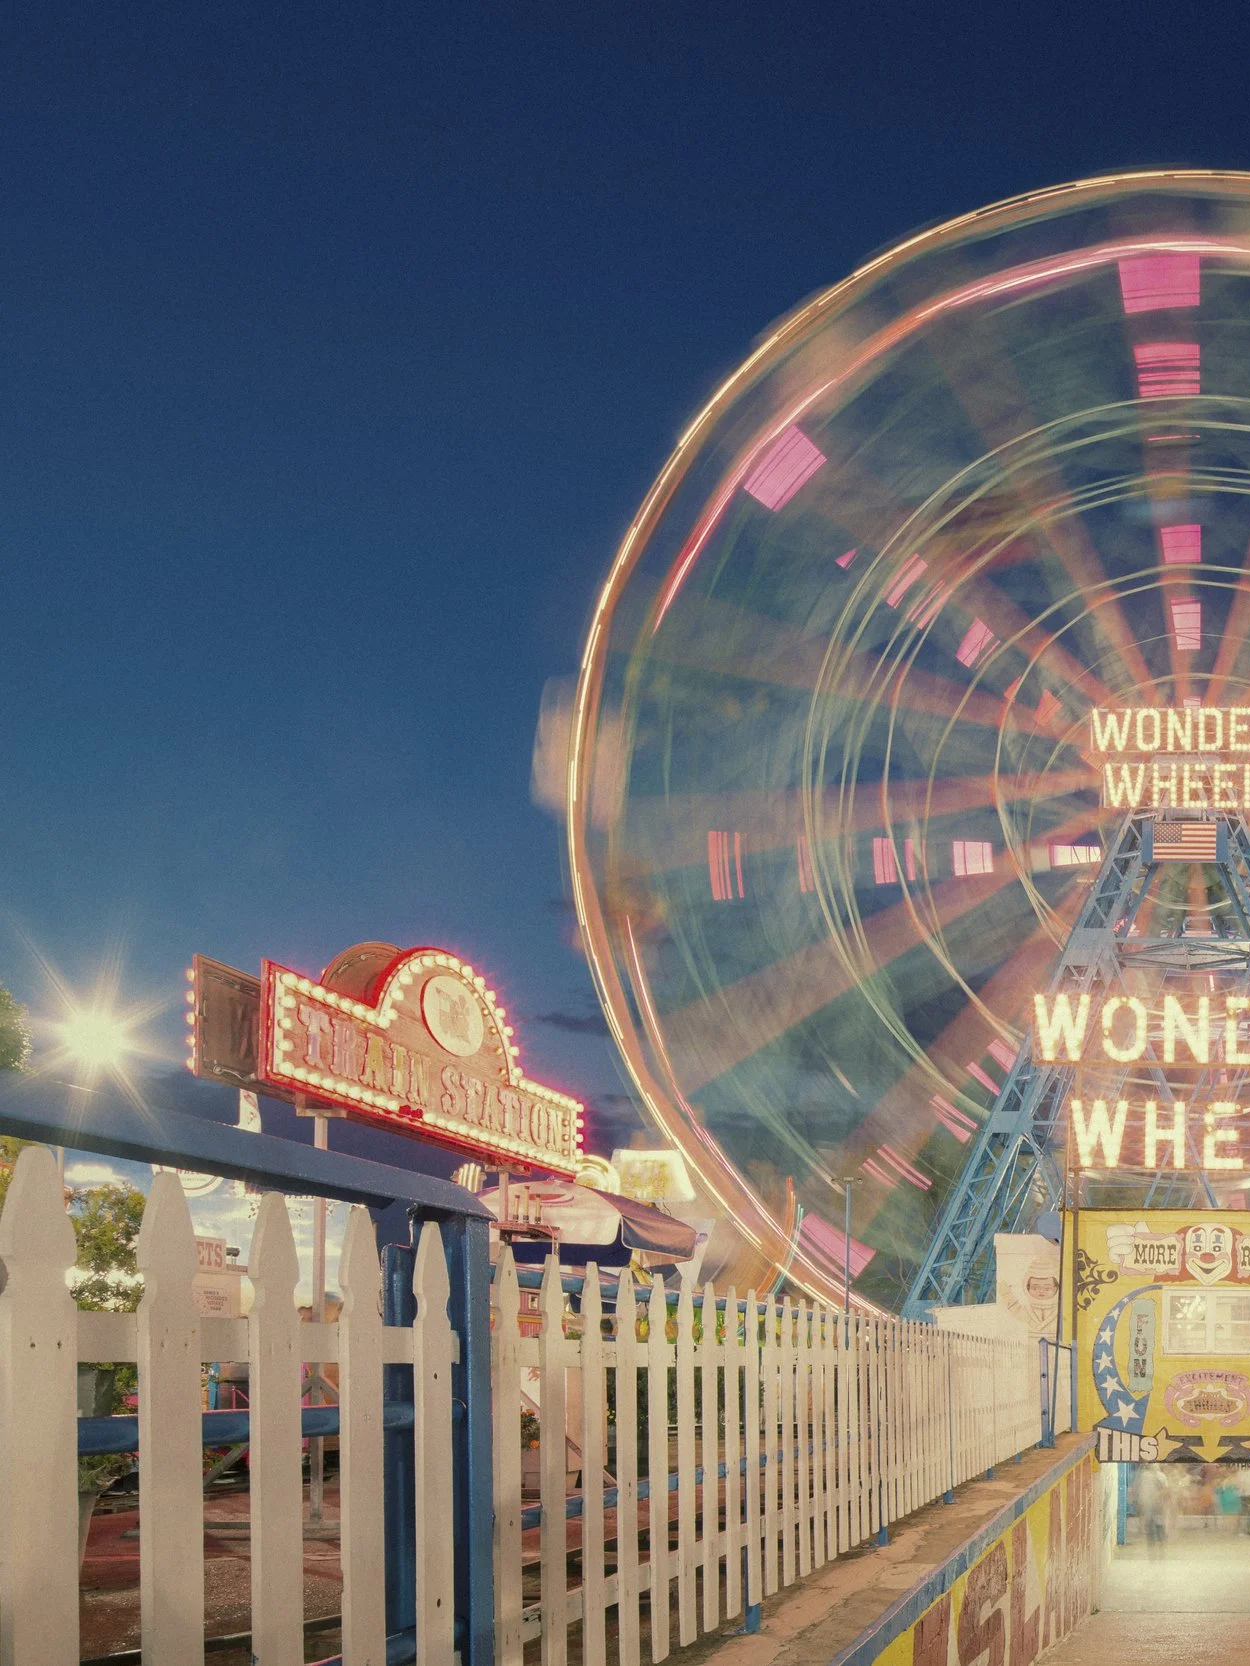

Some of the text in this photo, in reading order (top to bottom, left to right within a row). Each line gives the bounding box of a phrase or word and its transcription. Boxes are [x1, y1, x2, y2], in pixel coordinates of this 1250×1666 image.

[297, 1003, 563, 1153] TRAIN STATION
[1133, 1243, 1177, 1265] MORE
[1133, 1313, 1149, 1379] FUN
[1179, 1372, 1245, 1386] EXCITEMENT
[1097, 1427, 1159, 1462] THIS
